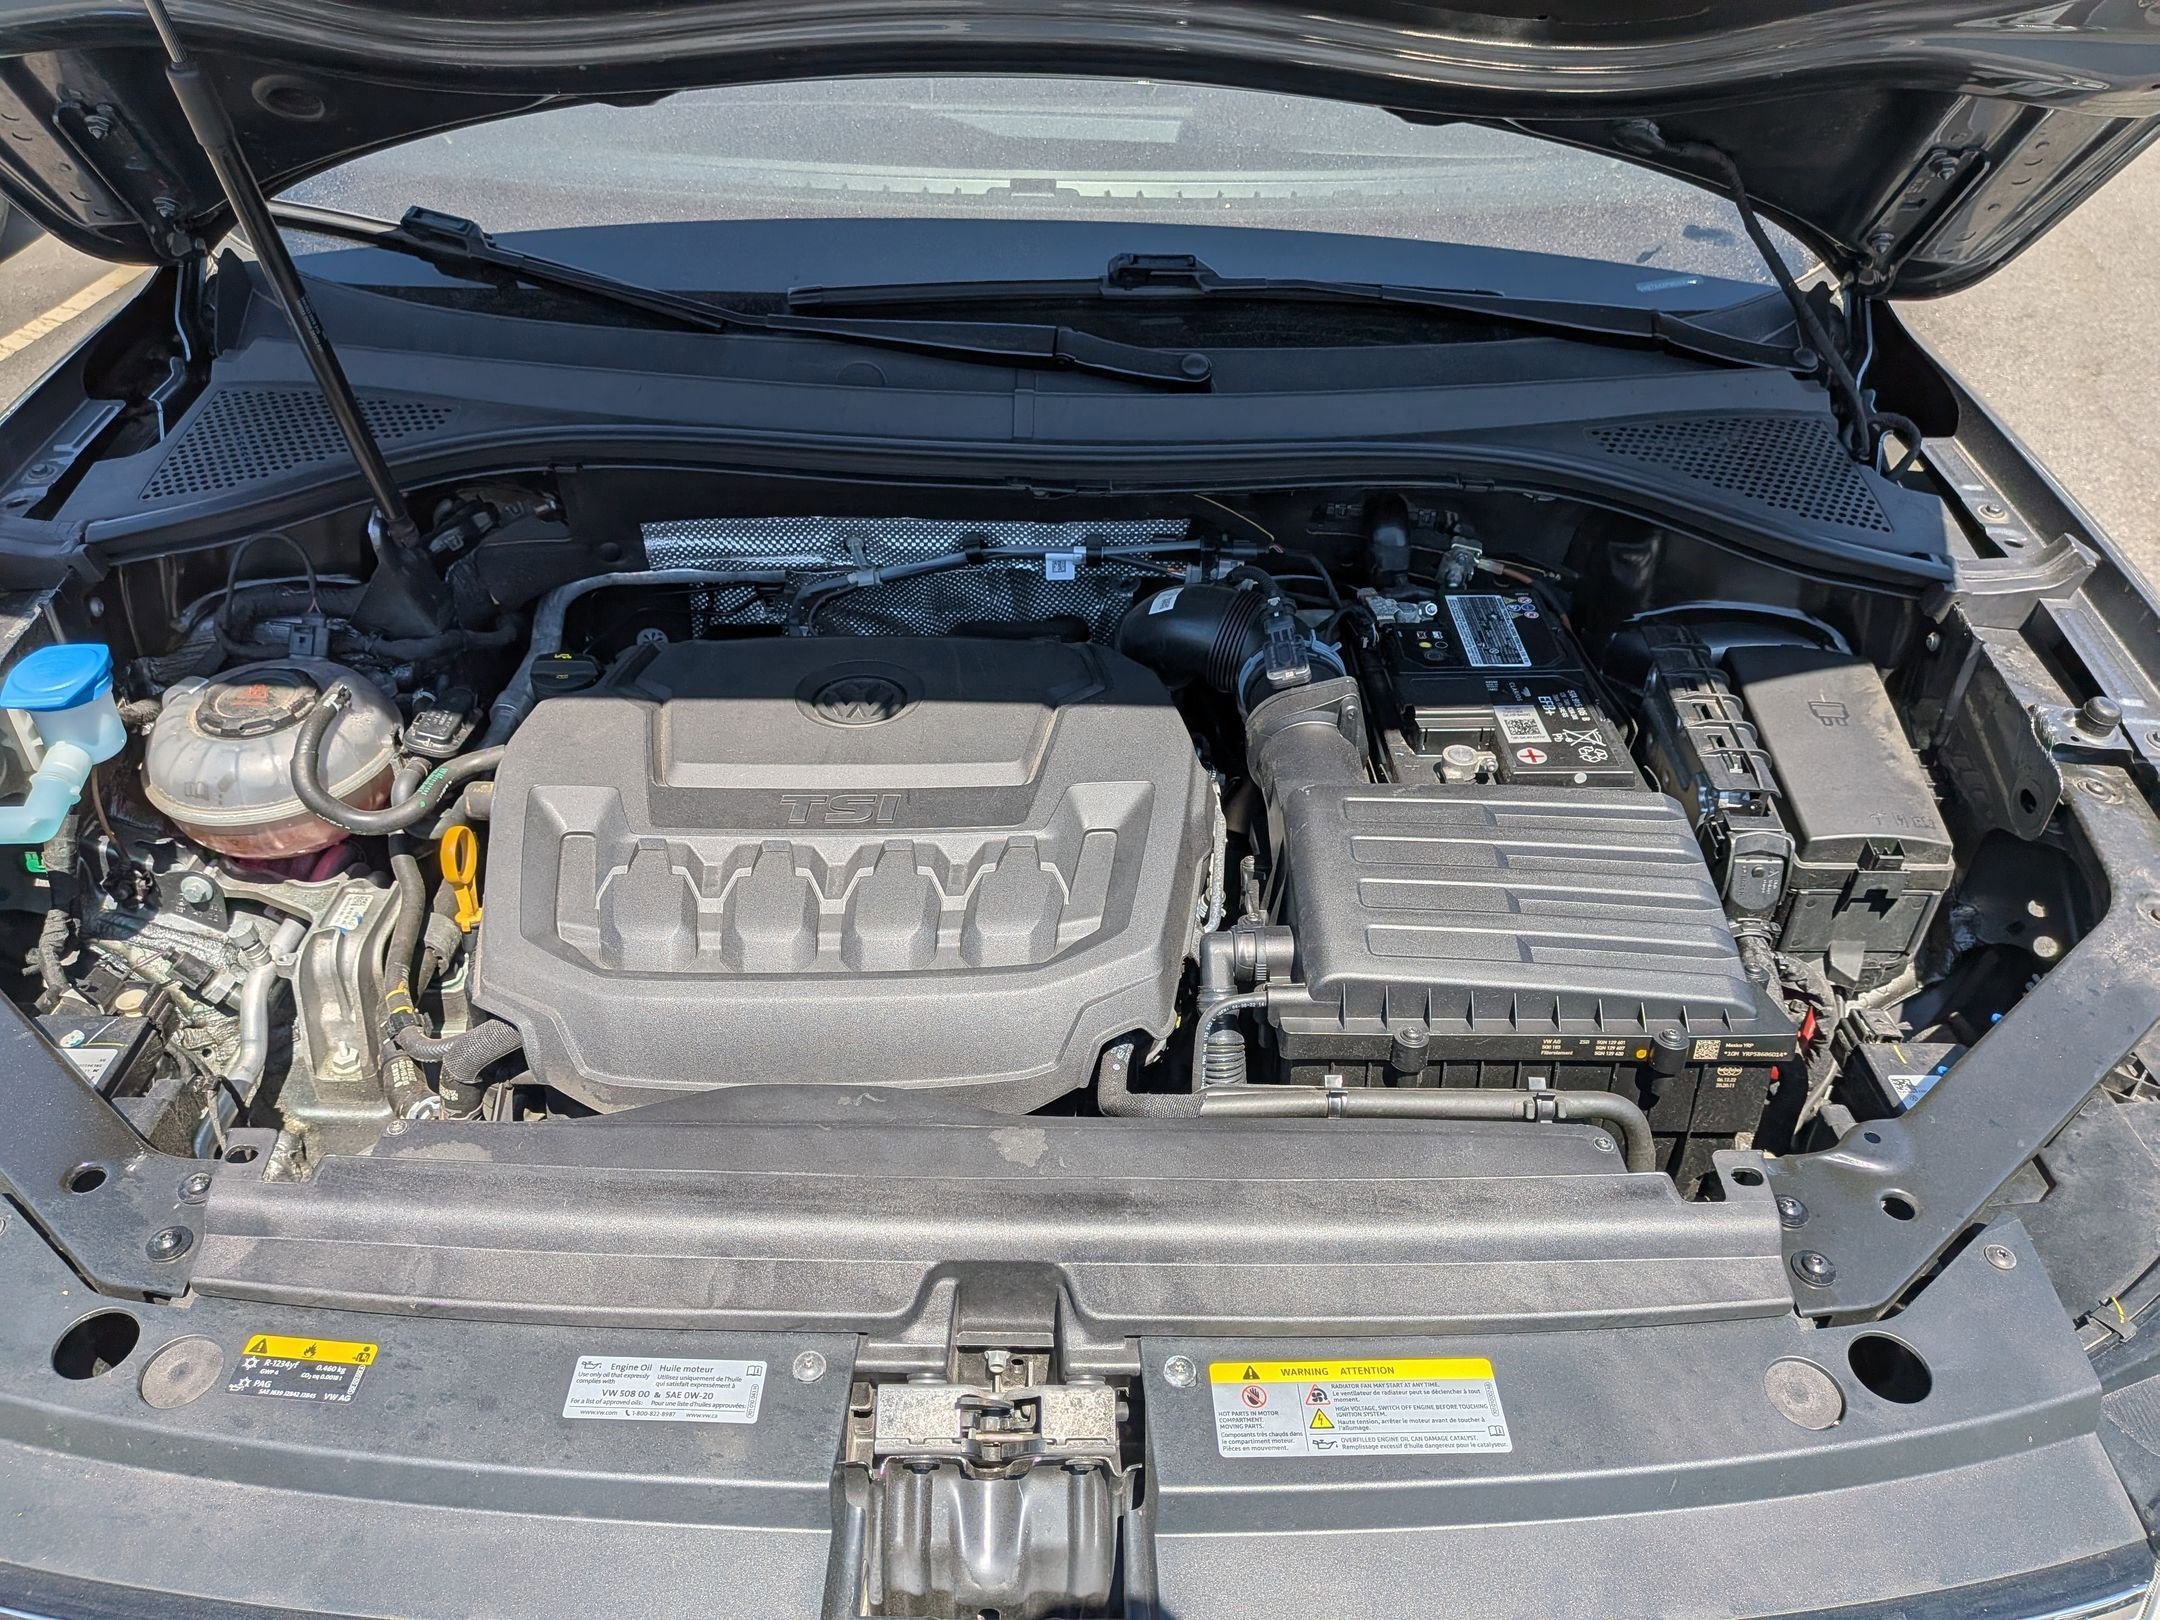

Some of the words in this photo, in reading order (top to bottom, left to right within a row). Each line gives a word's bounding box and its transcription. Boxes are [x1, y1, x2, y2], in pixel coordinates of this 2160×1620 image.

[1509, 681, 1523, 702] CLARIOS
[1537, 696, 1556, 716] EFB+
[1552, 733, 1564, 742] Pb
[780, 794, 901, 824] TSI
[263, 1359, 300, 1370] R-1234yf
[315, 1364, 336, 1373] 0.460
[337, 1366, 346, 1374] kg
[611, 1363, 638, 1372] Engine
[659, 1364, 681, 1372] Huile
[1280, 1368, 1329, 1377] WARNING
[1340, 1366, 1395, 1375] ATTENTION
[680, 1375, 715, 1383] uniquement
[253, 1380, 272, 1388] PAG
[602, 1389, 618, 1397] VW
[637, 1390, 650, 1398] 00
[665, 1391, 682, 1399] SAE
[684, 1392, 714, 1400] 0W-20
[603, 1399, 630, 1407] approved
[1228, 1438, 1269, 1446] compartiment
